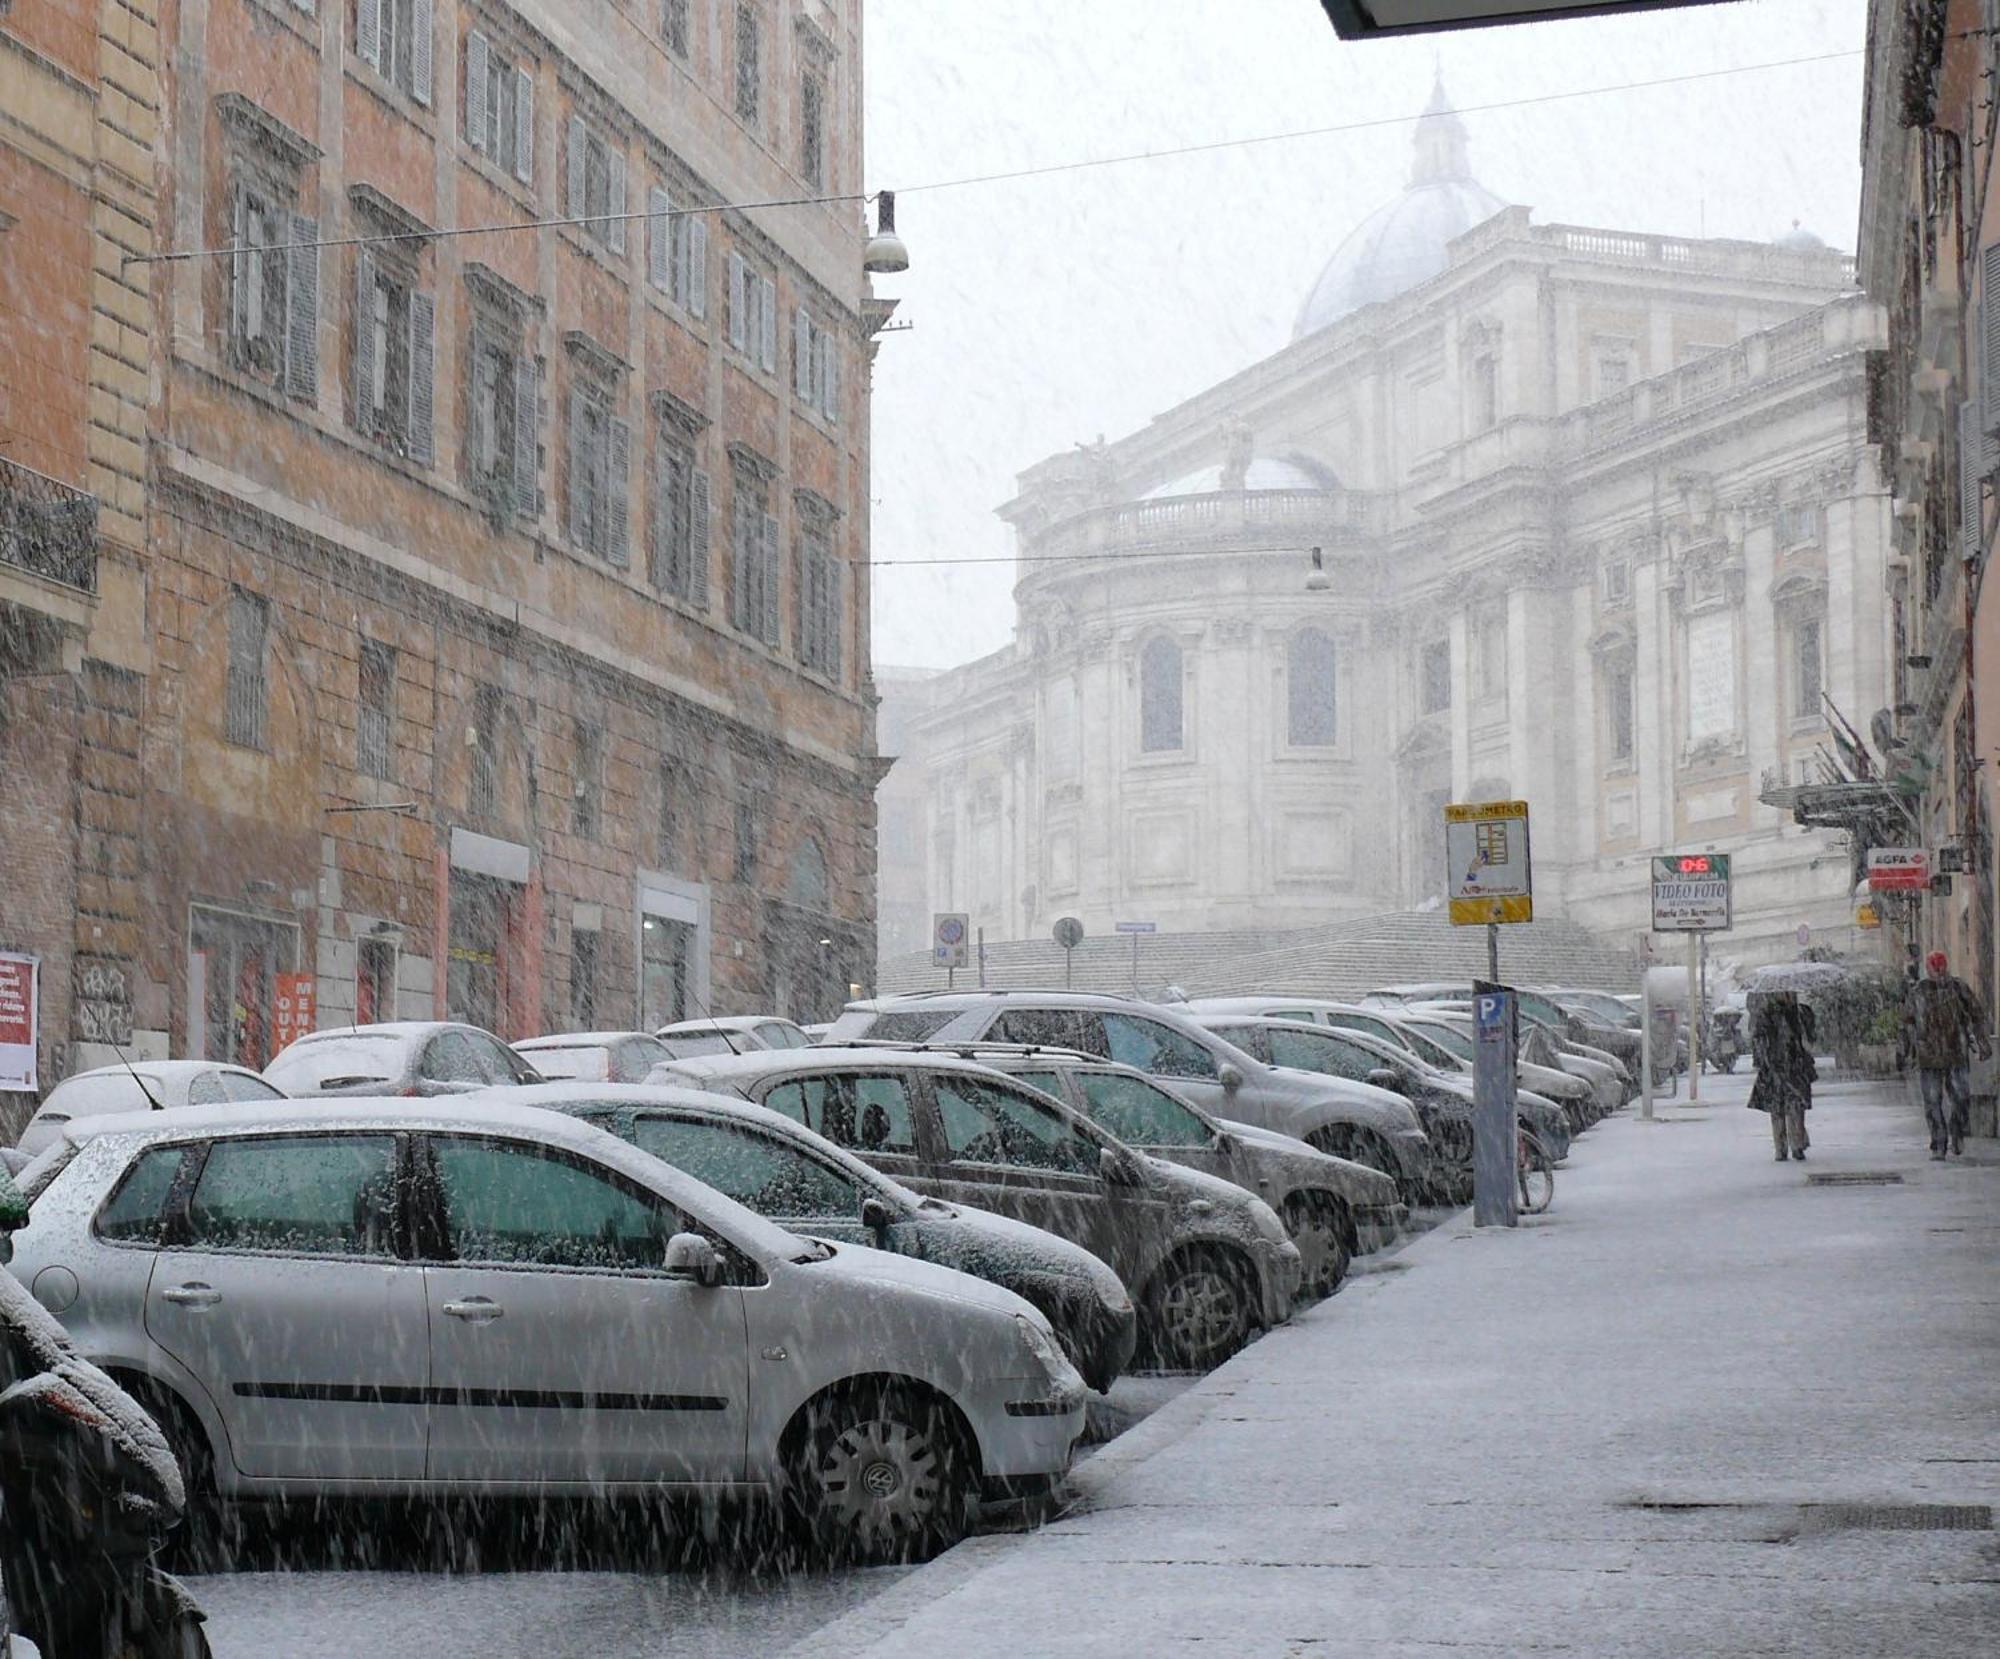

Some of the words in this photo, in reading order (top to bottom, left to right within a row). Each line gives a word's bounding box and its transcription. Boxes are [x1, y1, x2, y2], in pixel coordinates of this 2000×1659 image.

[1874, 854, 1908, 864] AGFA
[1655, 884, 1692, 899] VIDEO
[1694, 883, 1725, 898] FOTO
[1480, 998, 1496, 1020] P
